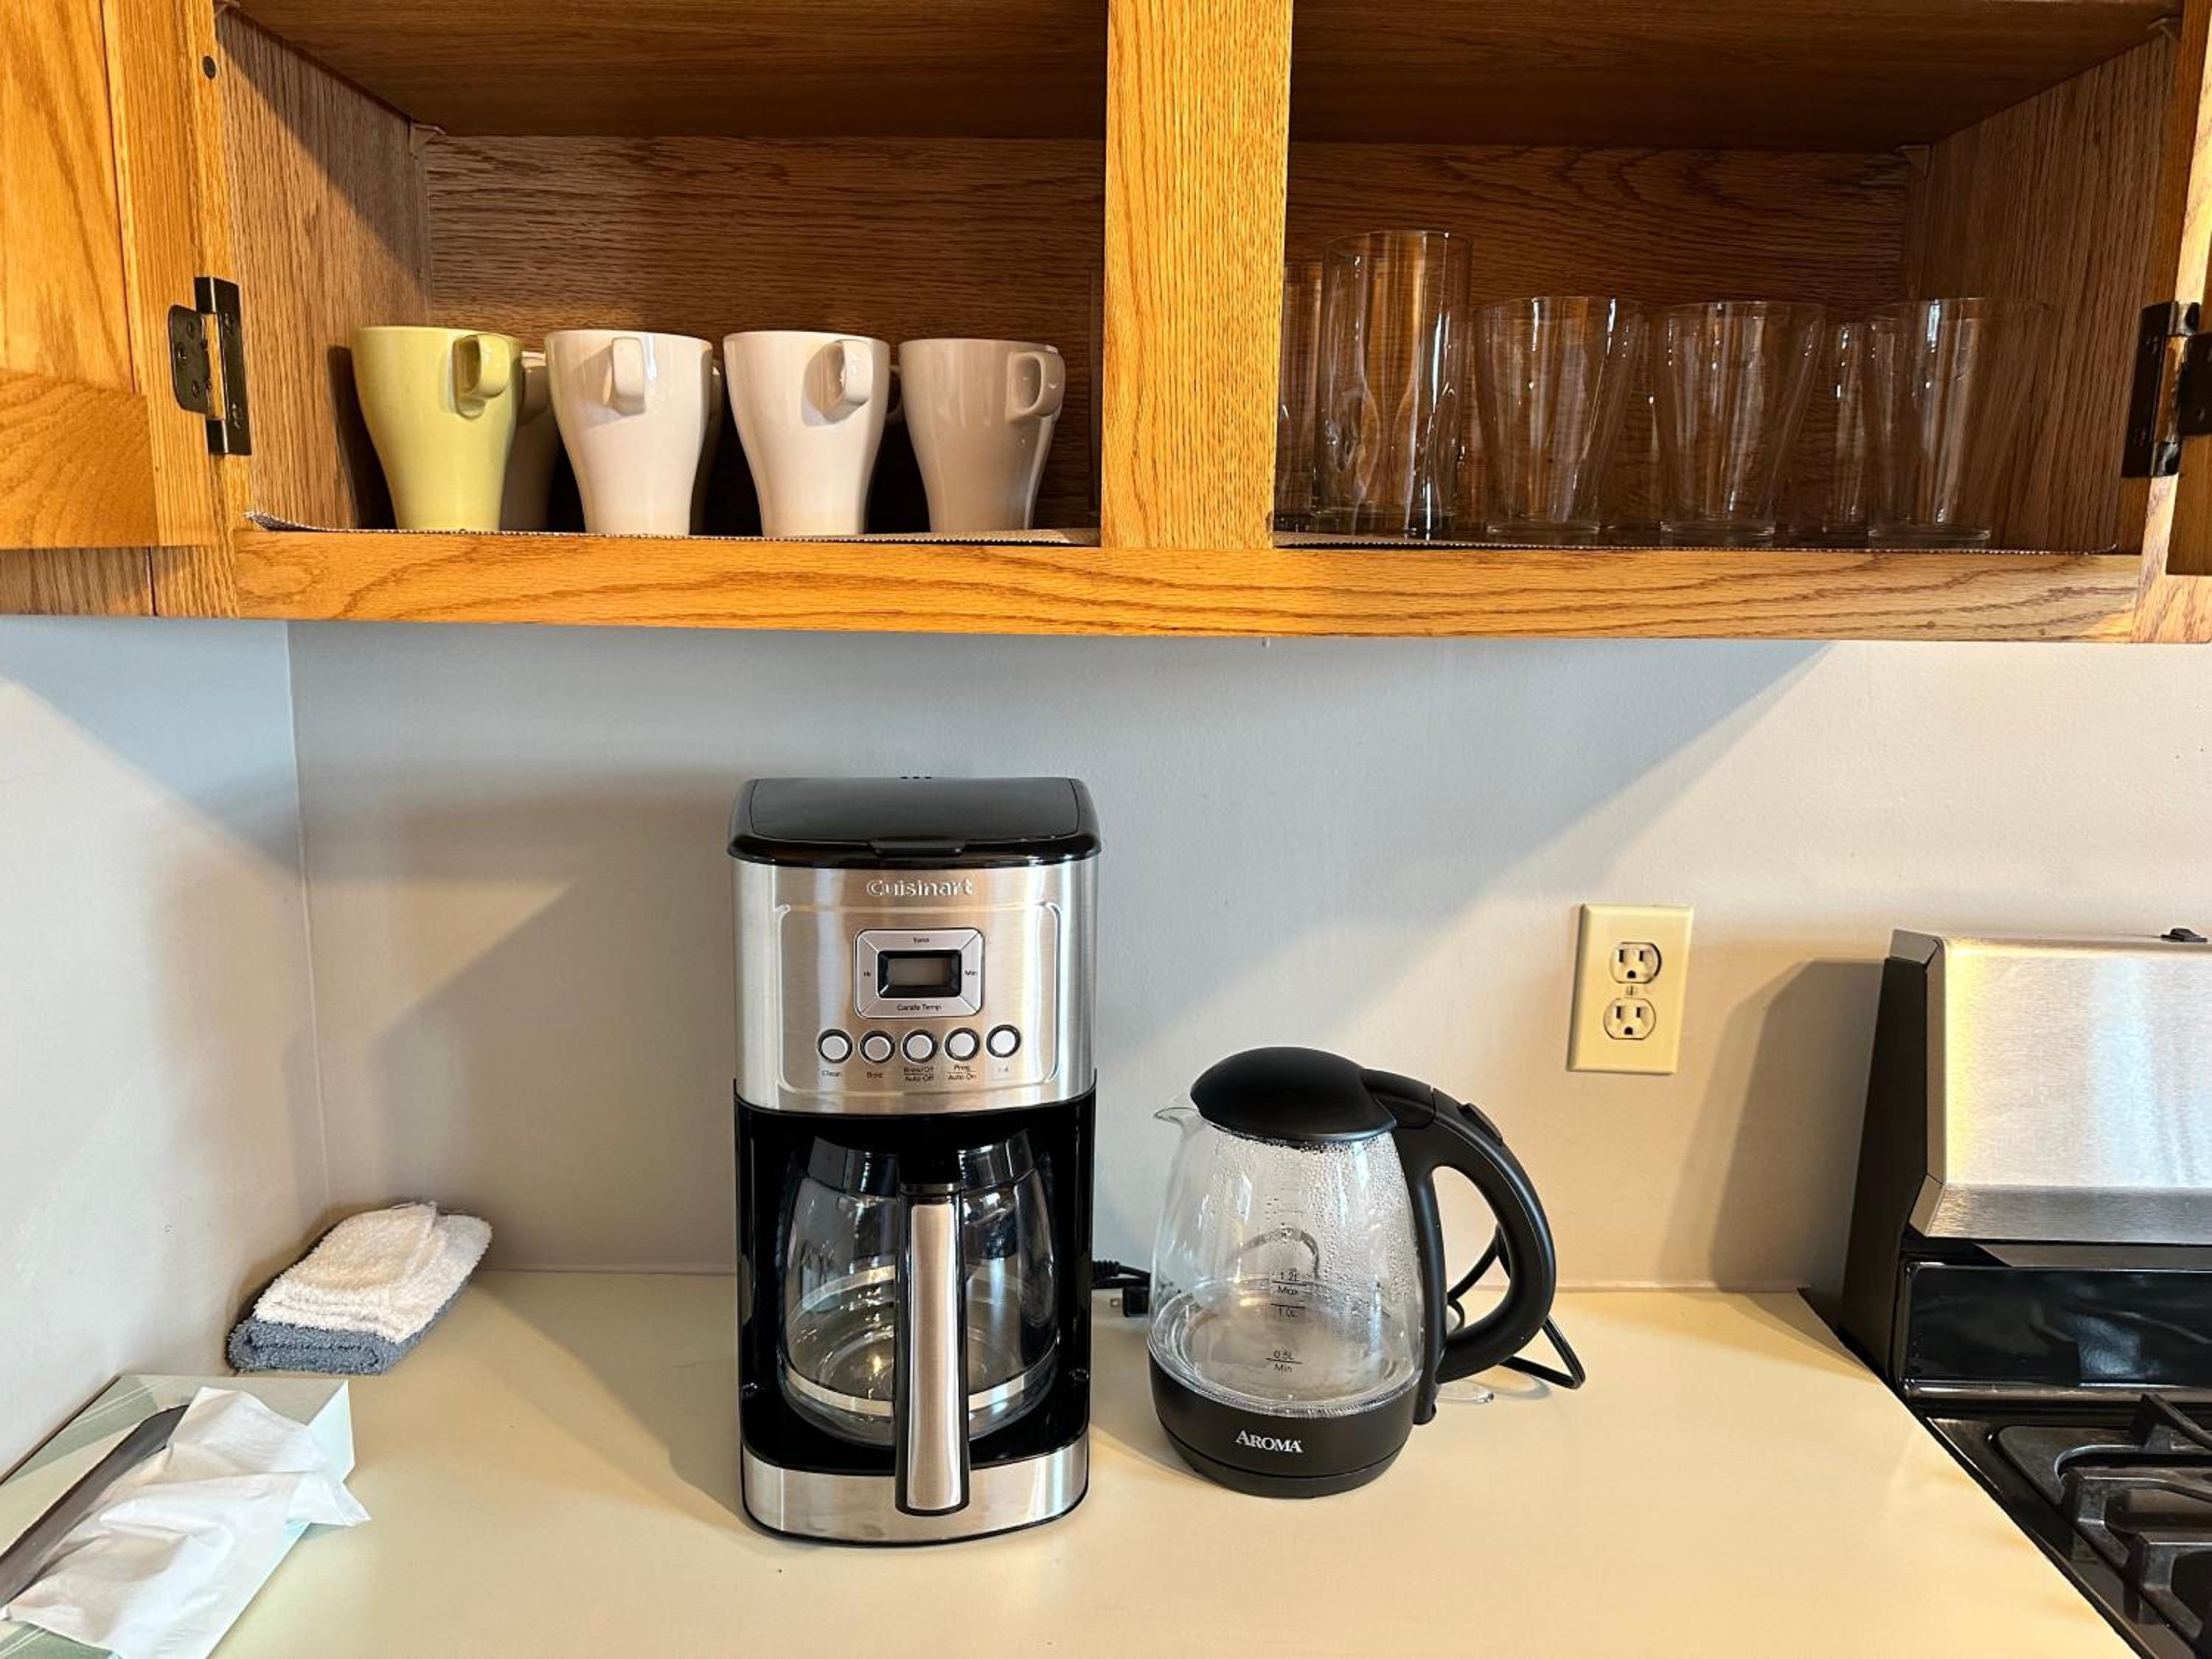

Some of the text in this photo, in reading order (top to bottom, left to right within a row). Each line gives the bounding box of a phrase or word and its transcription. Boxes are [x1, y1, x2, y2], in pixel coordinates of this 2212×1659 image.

[866, 879, 973, 897] Cuisinart
[922, 1004, 942, 1012] Temp
[1276, 1285, 1298, 1295] Max
[1274, 1363, 1293, 1372] Min
[1235, 1430, 1304, 1453] AROMA
